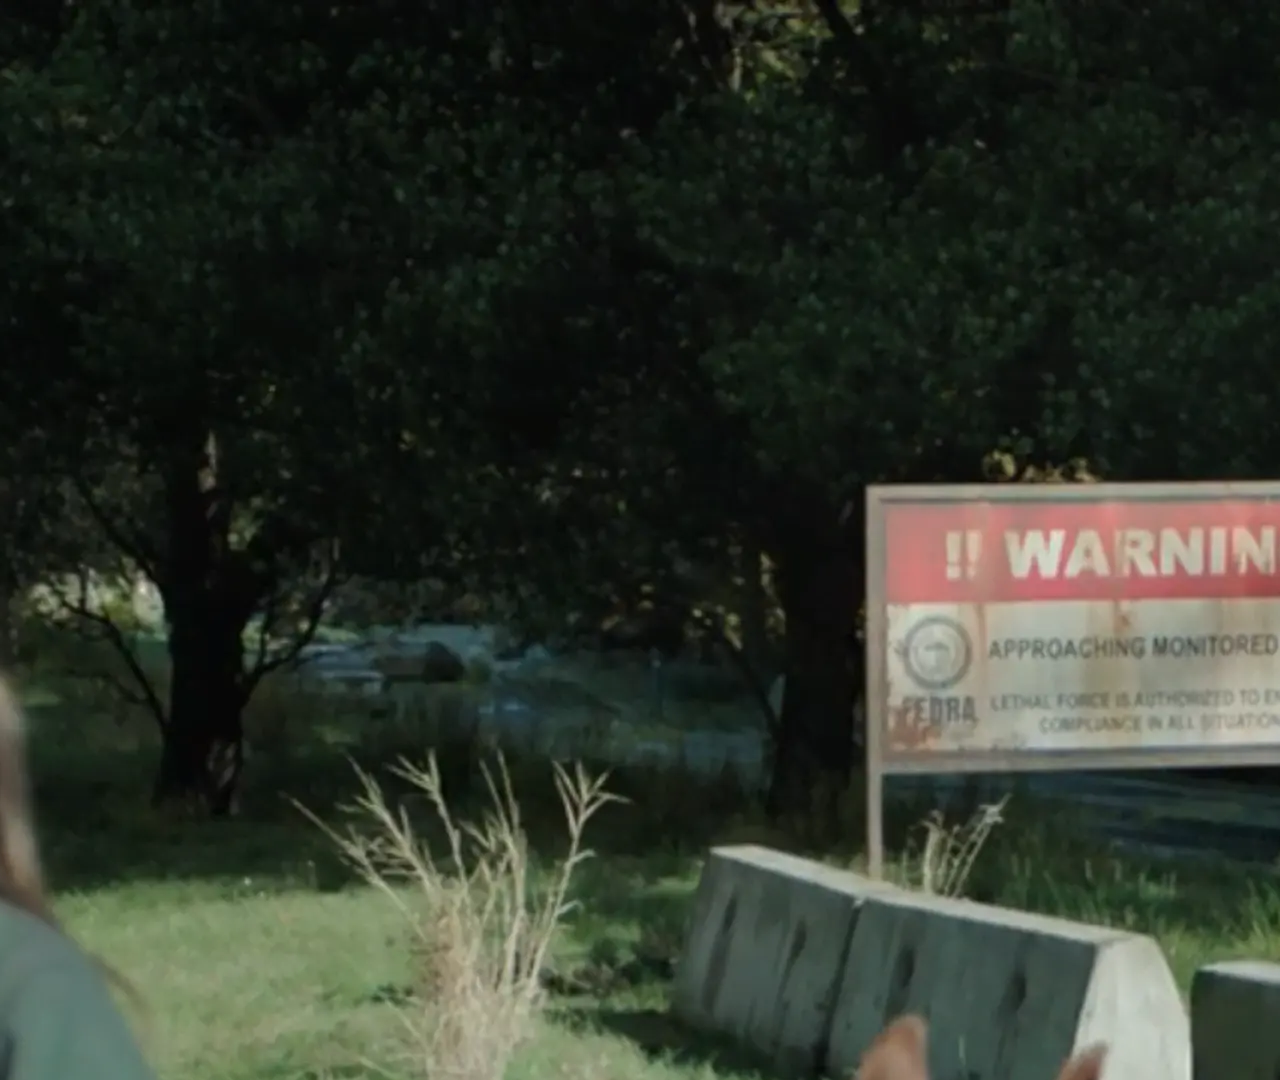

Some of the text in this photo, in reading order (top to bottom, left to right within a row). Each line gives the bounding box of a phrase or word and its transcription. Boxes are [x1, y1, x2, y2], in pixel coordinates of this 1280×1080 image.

[988, 636, 1147, 660] APPROACHING
[1151, 633, 1278, 658] MONITORED
[902, 695, 977, 723] FEDRA
[989, 693, 1052, 711] LETHAL
[1057, 691, 1109, 709] FORCE
[1133, 688, 1234, 708] AUTHORIZED
[1240, 688, 1260, 706] TO
[1038, 714, 1142, 734] COMPLIANCE
[1147, 714, 1163, 731] IN
[1169, 713, 1195, 731] ALL
